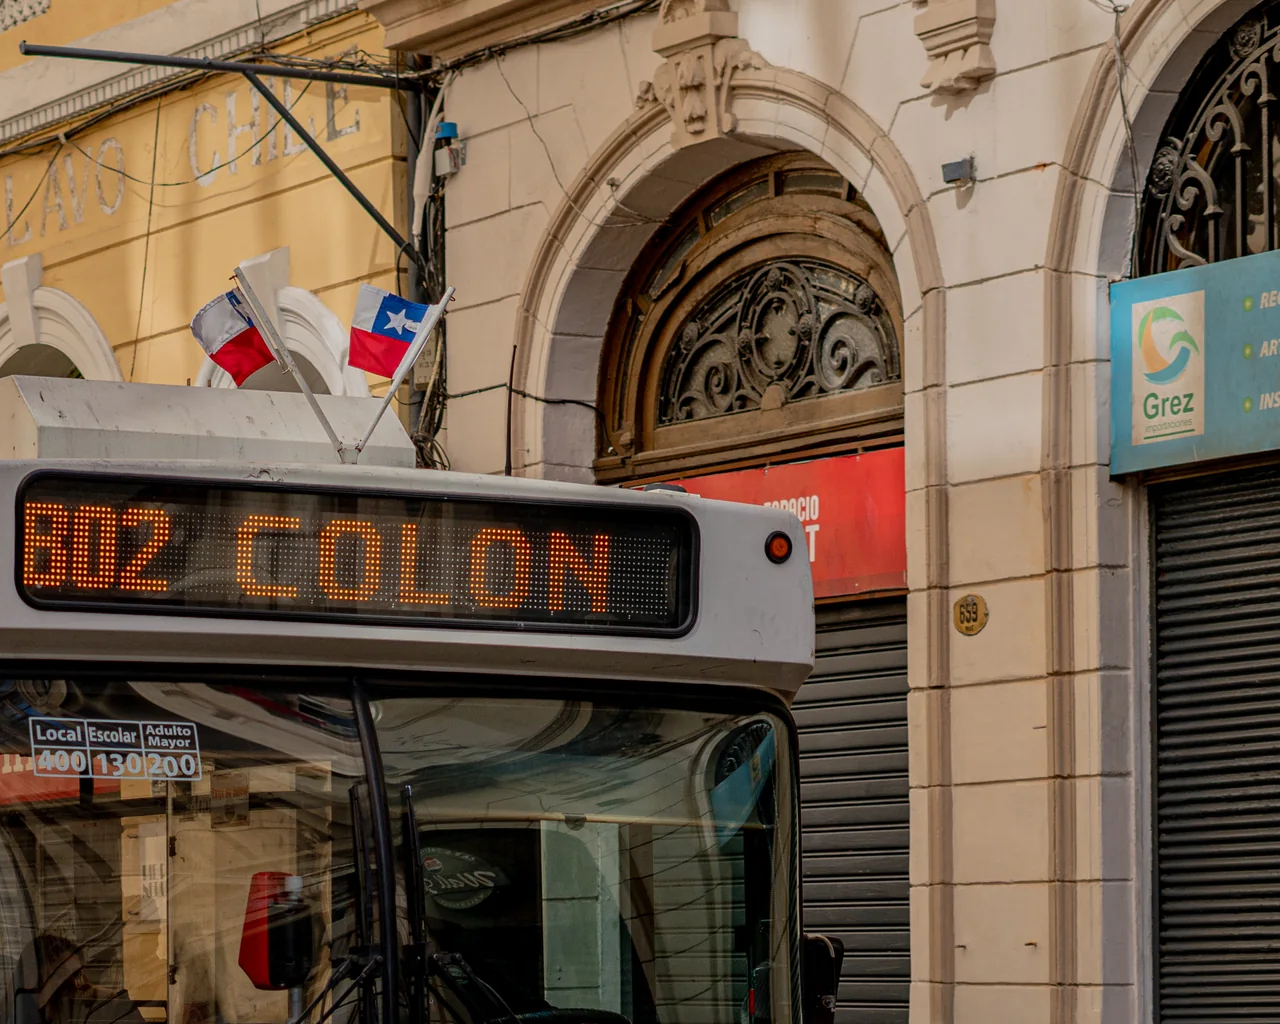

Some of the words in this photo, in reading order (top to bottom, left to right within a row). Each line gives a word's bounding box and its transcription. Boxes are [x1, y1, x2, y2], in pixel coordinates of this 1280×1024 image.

[189, 47, 361, 188] CHILE
[1143, 392, 1195, 420] Grez
[1144, 418, 1194, 434] importaciones
[236, 513, 610, 614] COLON
[959, 601, 978, 624] 659
[35, 724, 83, 743] Local
[88, 726, 137, 744] Escolar
[145, 724, 192, 737] Adulto
[147, 736, 191, 749] Mayor
[37, 749, 87, 772] 400
[97, 752, 142, 777] 130
[148, 753, 197, 777] 200
